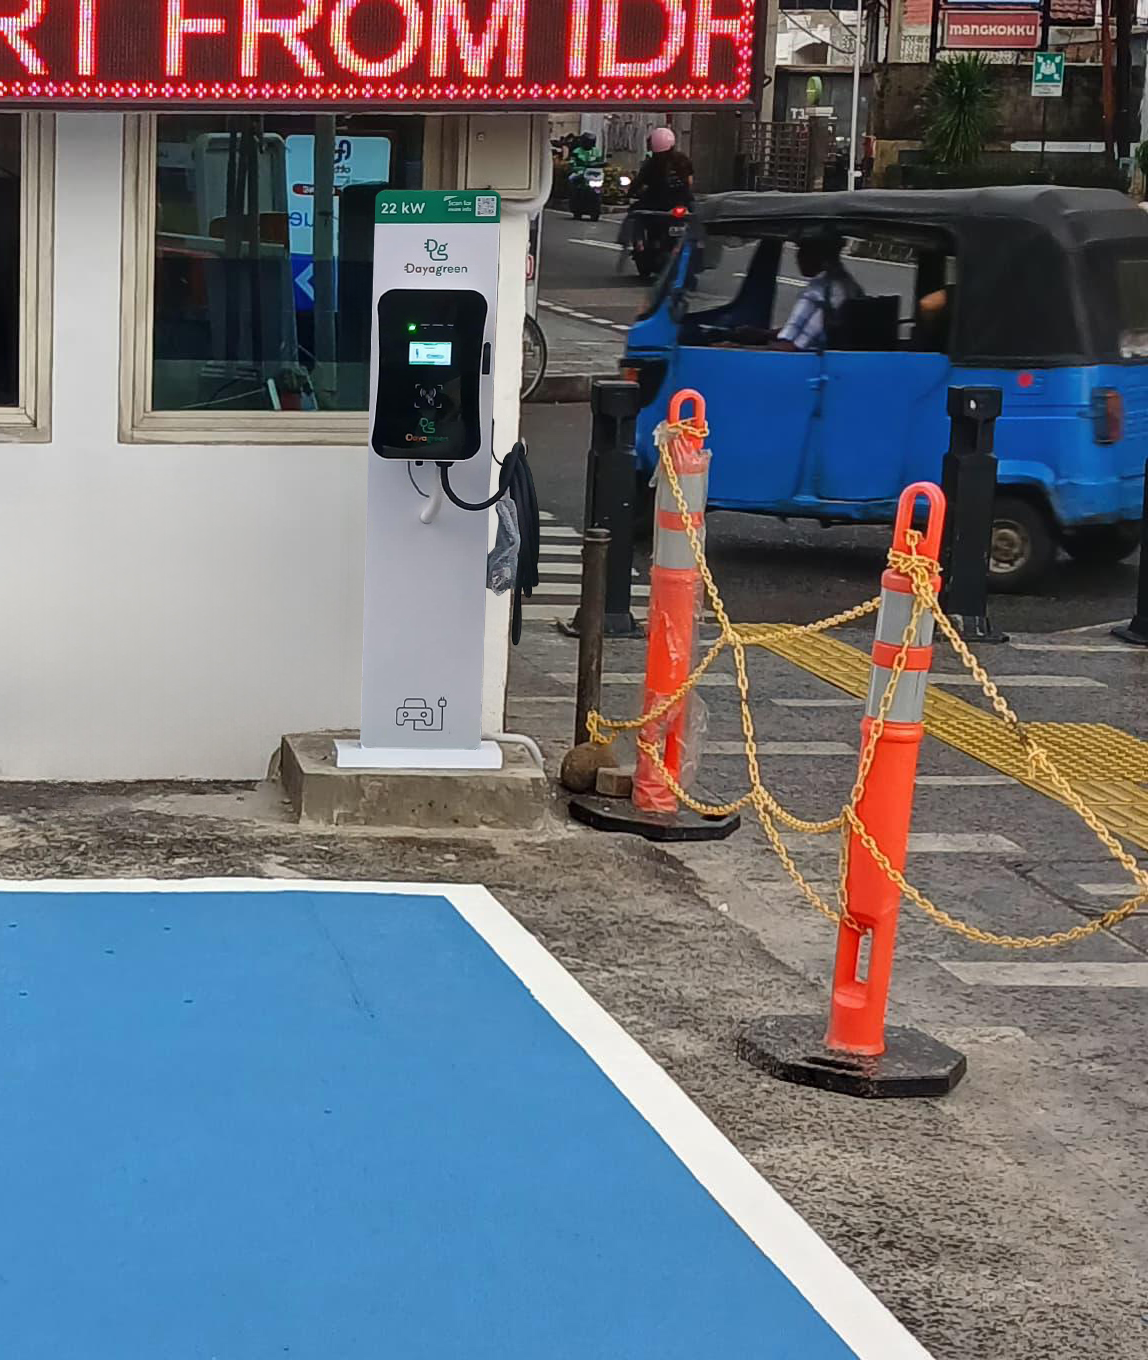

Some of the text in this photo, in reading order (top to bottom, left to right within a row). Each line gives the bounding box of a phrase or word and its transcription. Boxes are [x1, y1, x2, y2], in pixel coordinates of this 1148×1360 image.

[381, 201, 426, 214] 22 kW
[404, 262, 468, 277] Dayagreen
